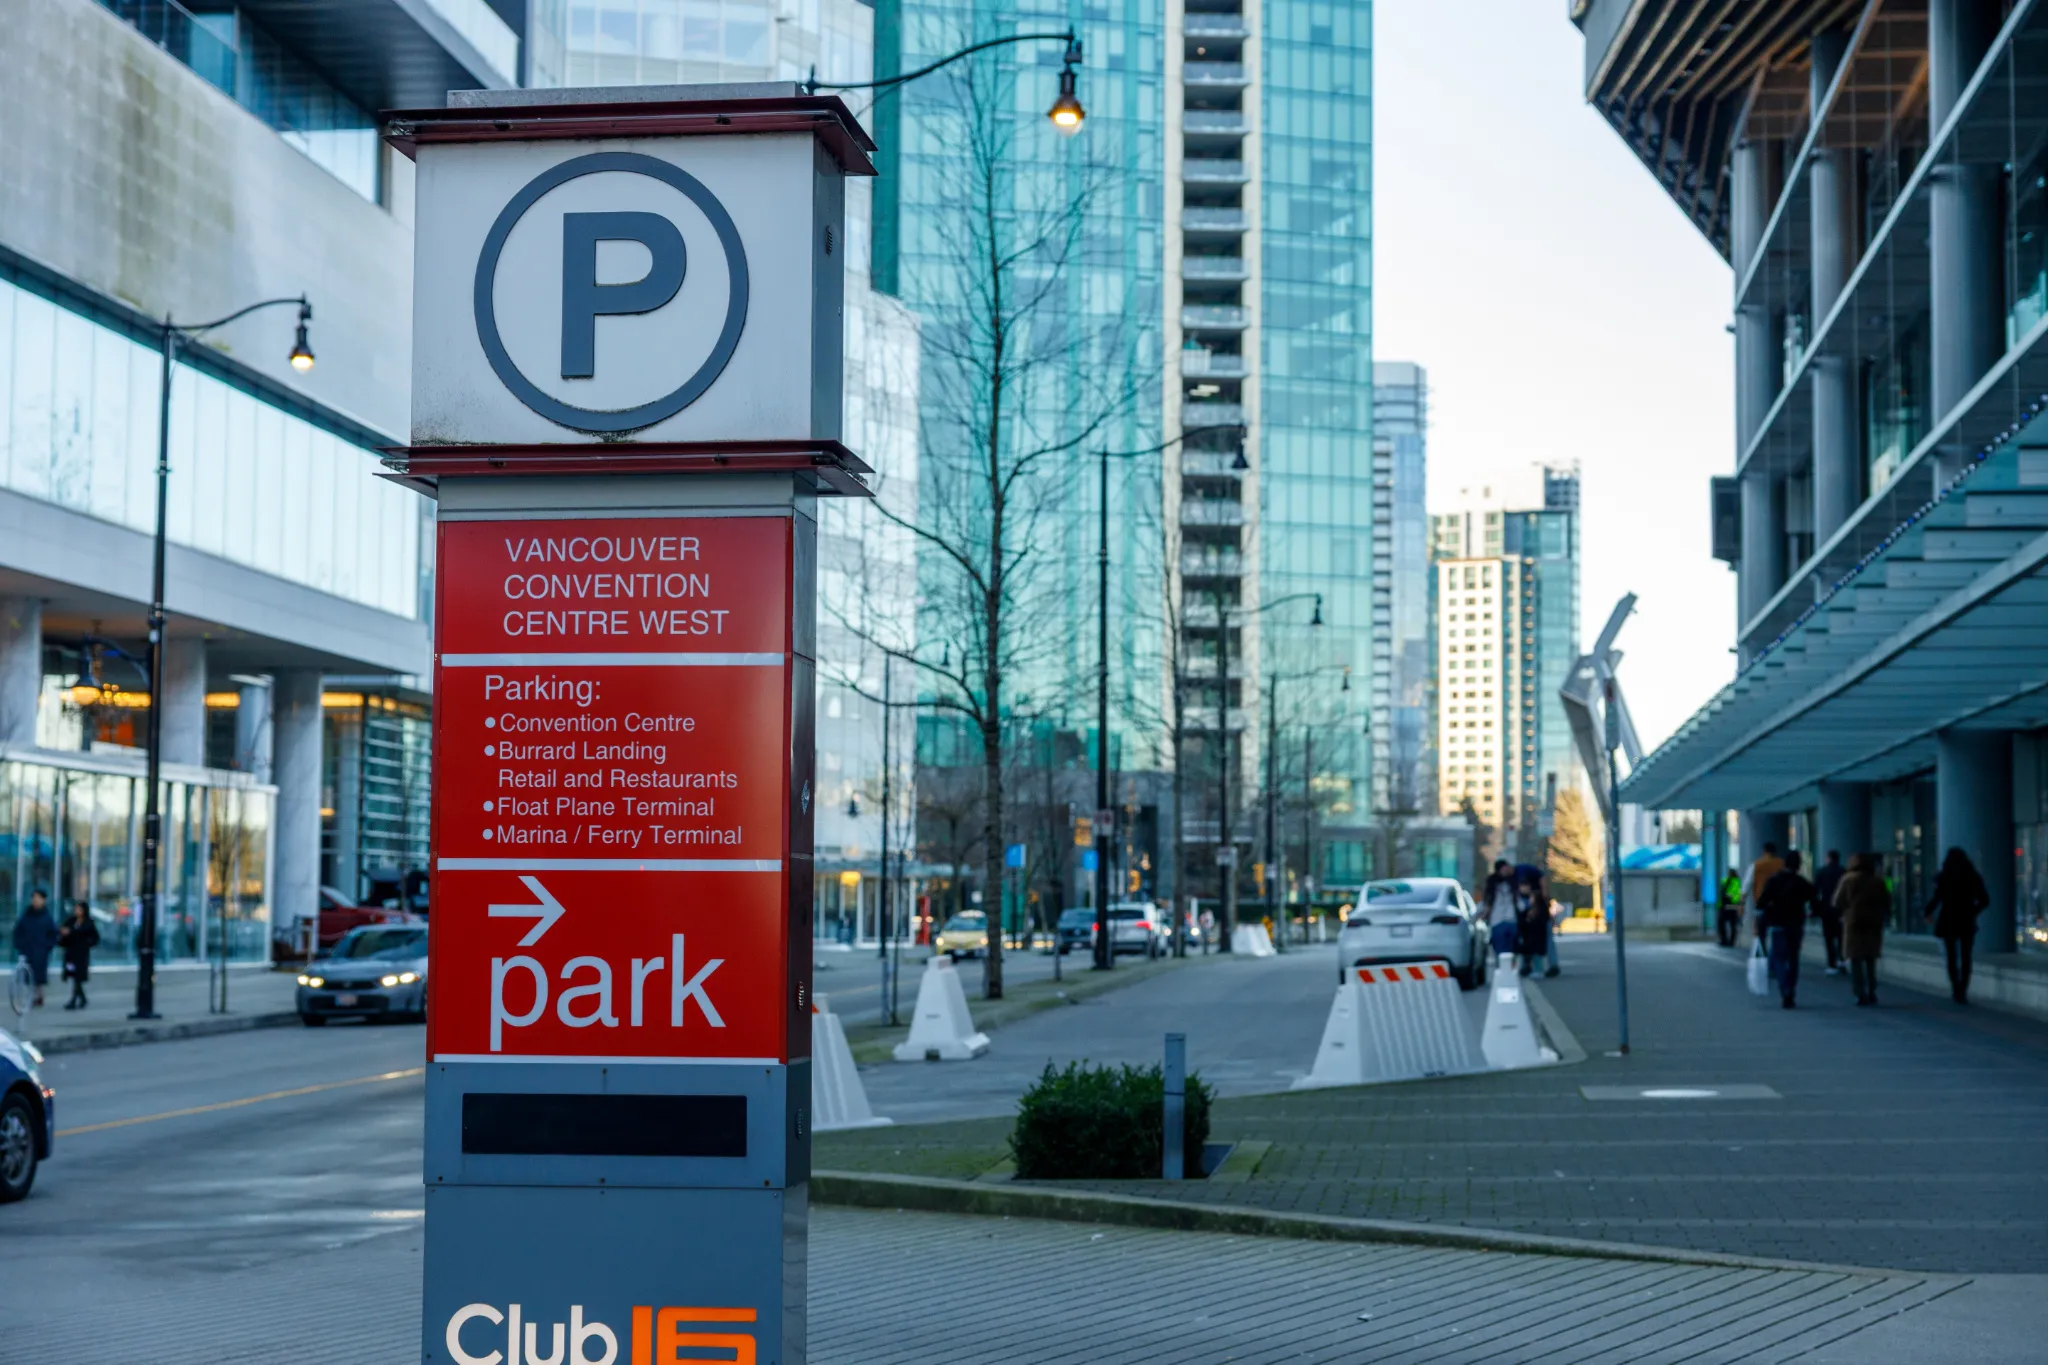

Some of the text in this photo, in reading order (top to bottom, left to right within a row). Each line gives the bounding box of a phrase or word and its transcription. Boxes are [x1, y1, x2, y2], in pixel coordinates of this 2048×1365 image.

[561, 211, 687, 379] P
[505, 537, 700, 563] VANCOUVER
[503, 573, 710, 600] CONVENTION
[503, 610, 730, 636] CENTRE WEST
[485, 675, 601, 707] Parking:
[500, 713, 695, 732] Convention Centre
[499, 741, 666, 764] Burrard Landing
[499, 769, 738, 788] Retail and Restaurants
[498, 797, 714, 816] Float Plane Terminal
[497, 825, 742, 849] Marina / Ferry Terminal
[488, 933, 727, 1051] park
[446, 1303, 618, 1365] Club
